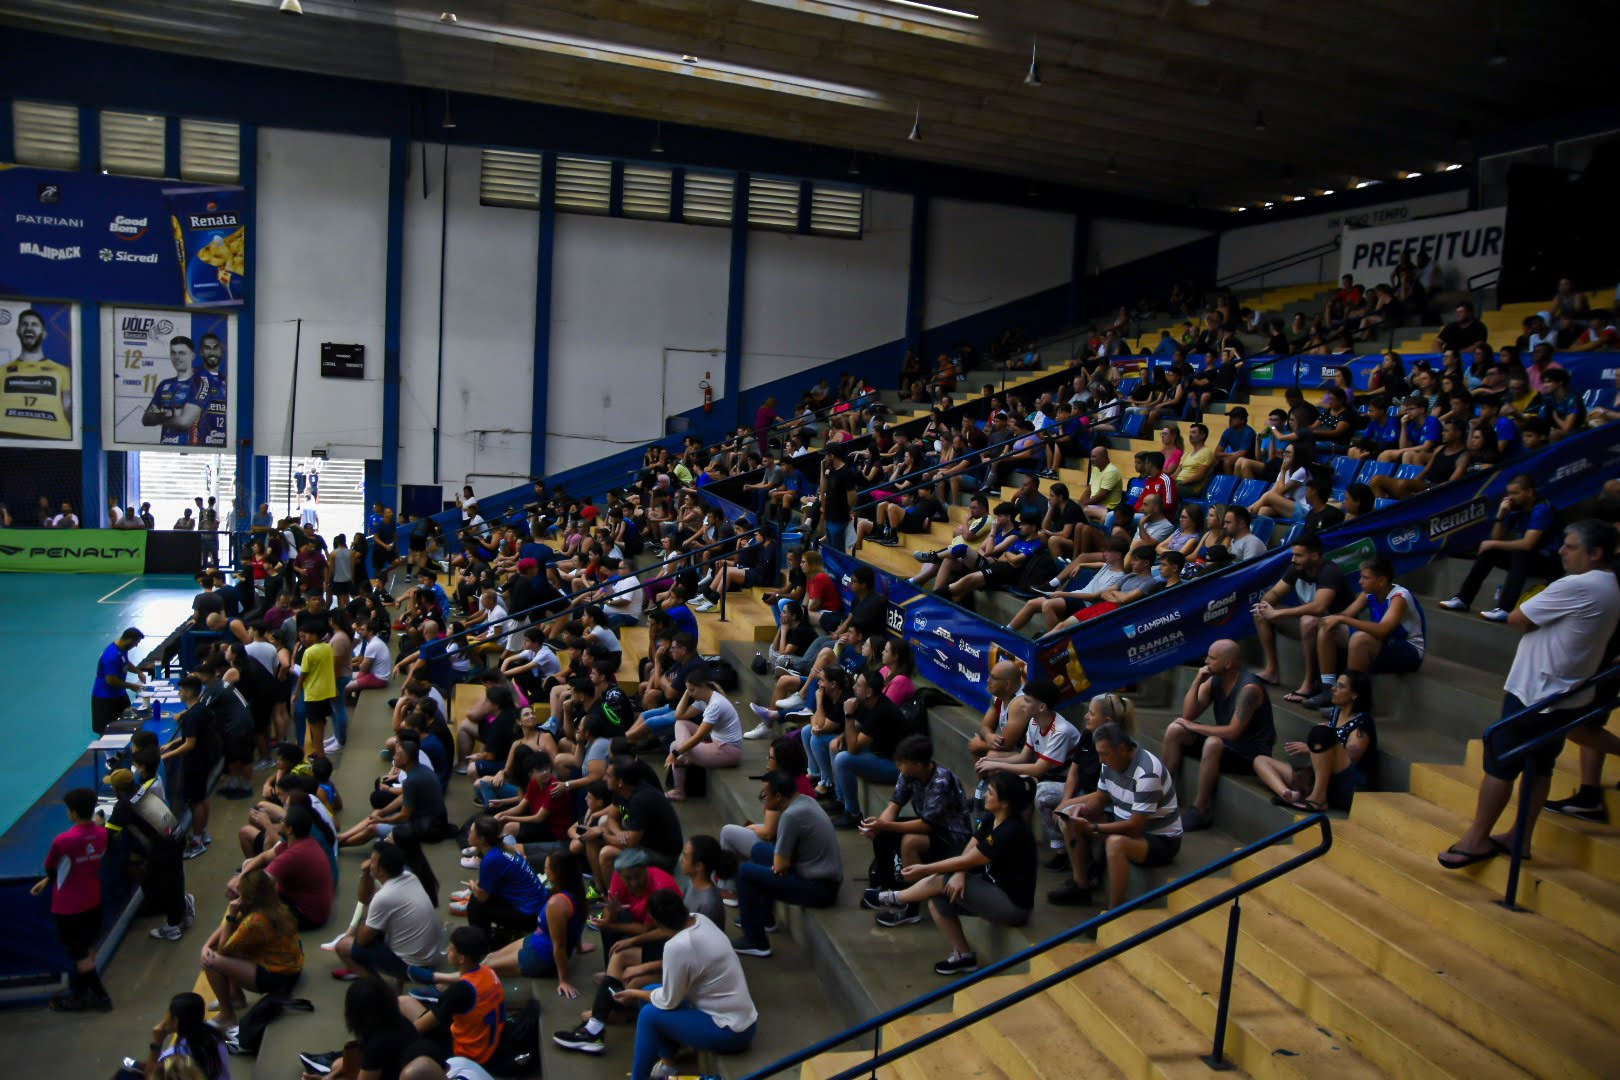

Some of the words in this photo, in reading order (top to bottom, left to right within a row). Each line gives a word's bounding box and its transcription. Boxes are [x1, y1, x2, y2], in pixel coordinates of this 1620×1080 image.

[16, 214, 84, 228] PATRIANI
[115, 215, 148, 227] Good
[190, 214, 237, 227] Renata
[109, 222, 138, 234] Bom
[116, 252, 158, 263] Sicredi
[125, 349, 142, 368] 12
[144, 374, 157, 392] 11
[24, 396, 37, 406] 17
[8, 410, 54, 419] Renata
[216, 417, 224, 427] 12
[1429, 503, 1485, 533] Renata
[1392, 530, 1416, 545] EMS
[30, 548, 139, 558] PENALTY
[1208, 592, 1236, 611] Good
[1203, 606, 1228, 622] Bom
[1137, 611, 1181, 633] CAMPINAS
[1139, 631, 1184, 652] SANASA
